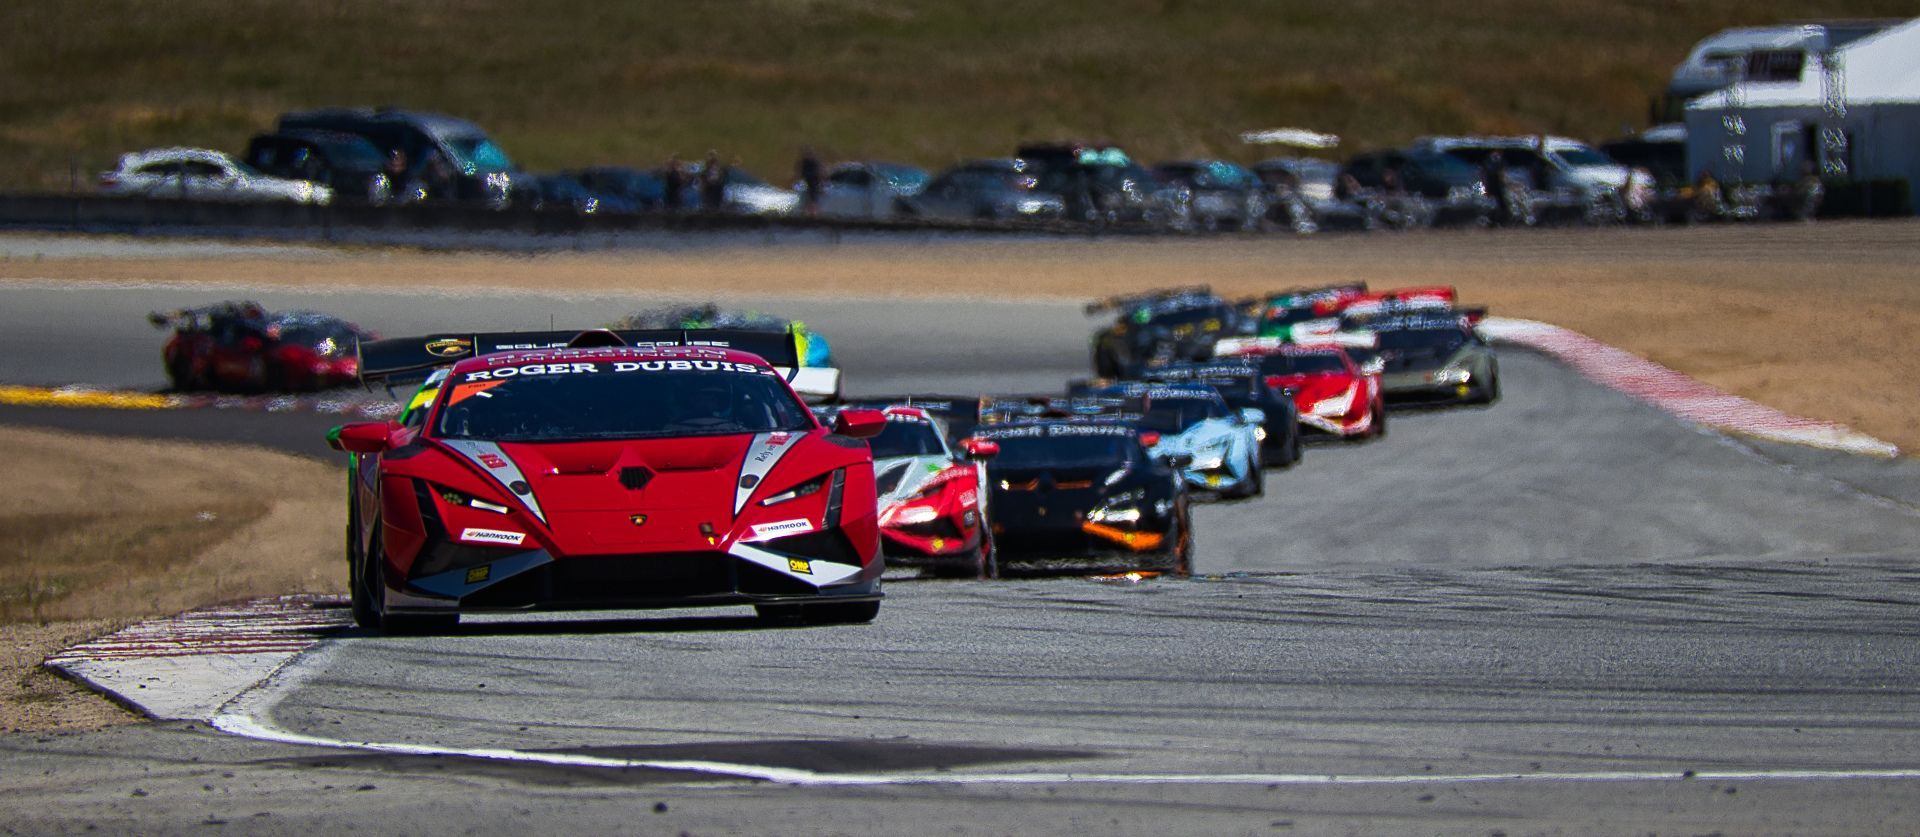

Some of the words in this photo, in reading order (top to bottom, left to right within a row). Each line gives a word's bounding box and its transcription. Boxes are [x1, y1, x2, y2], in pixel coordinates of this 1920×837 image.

[466, 363, 599, 381] ROGER
[613, 360, 758, 373] DUBUIS
[789, 560, 809, 571] OMP
